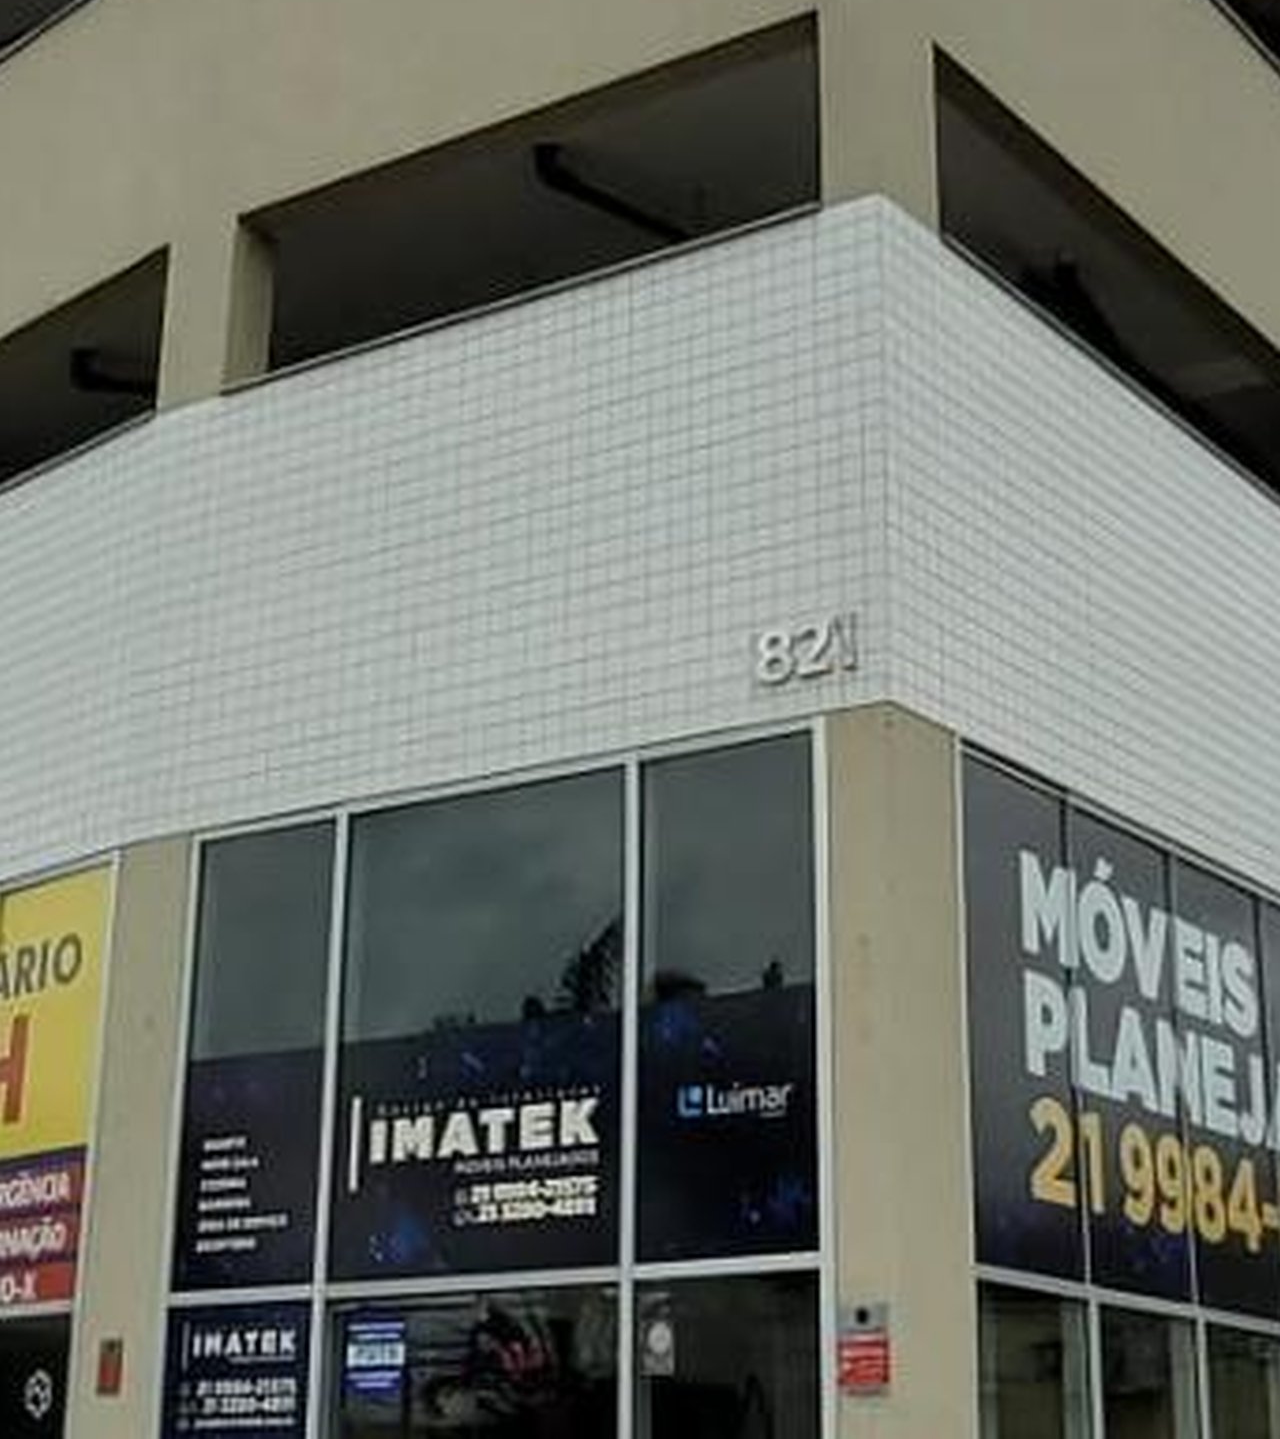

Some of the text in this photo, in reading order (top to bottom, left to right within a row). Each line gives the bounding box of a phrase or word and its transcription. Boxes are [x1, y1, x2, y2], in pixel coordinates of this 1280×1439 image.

[757, 612, 860, 686] 821
[1019, 849, 1259, 1038] MÓVEIS
[370, 1097, 599, 1164] IMATEK
[1030, 1097, 1104, 1215] 21
[192, 1330, 296, 1358] IMATEK
